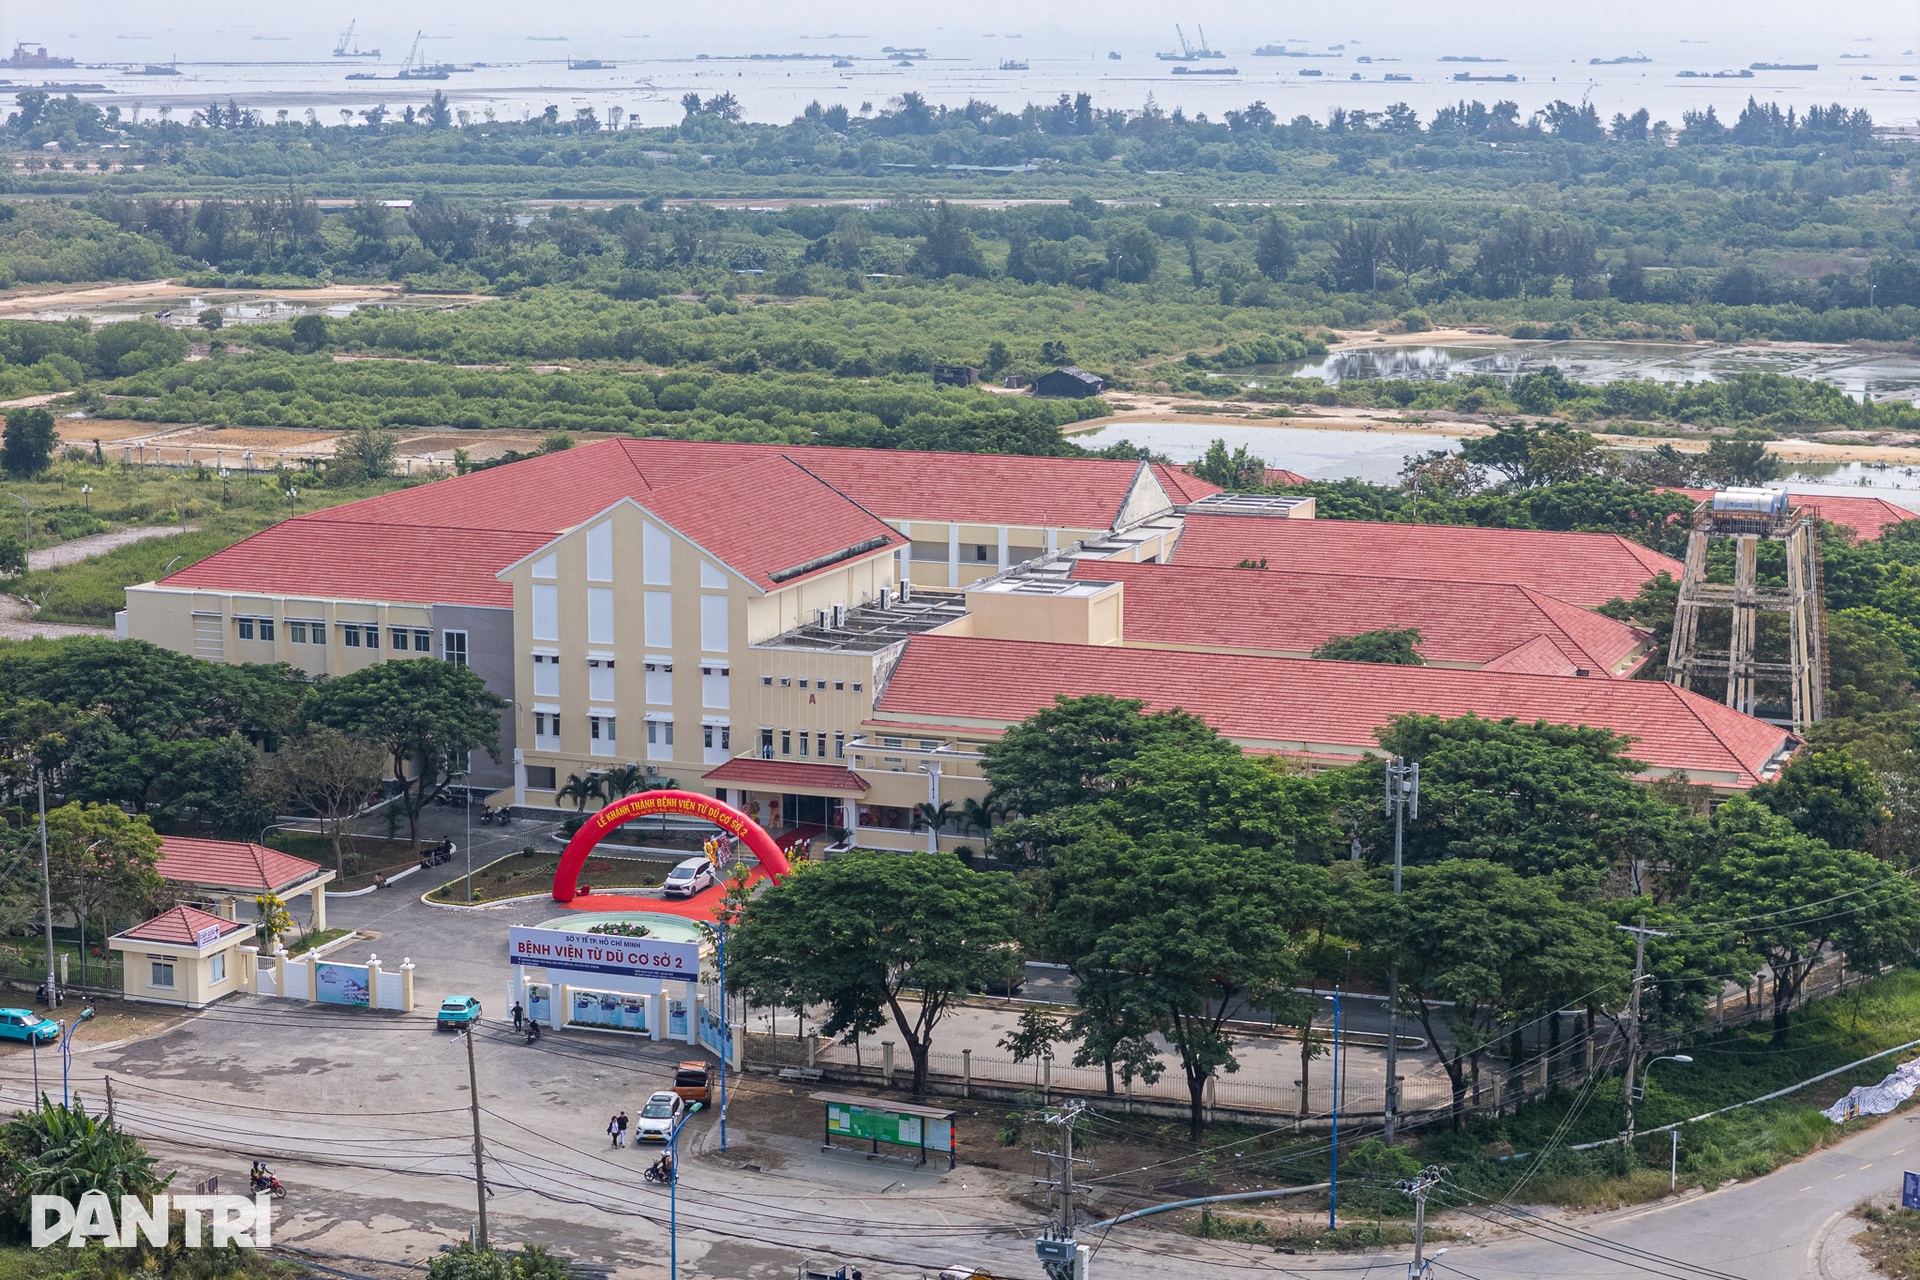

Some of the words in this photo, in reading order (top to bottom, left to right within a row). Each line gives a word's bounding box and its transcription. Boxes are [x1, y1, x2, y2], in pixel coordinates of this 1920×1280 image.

[808, 693, 816, 704] A
[596, 814, 608, 828] LỄ
[605, 804, 631, 822] KHÁNH
[630, 798, 655, 812] THÀNH
[657, 796, 677, 808] BỆNH
[678, 797, 696, 811] VIỆN
[708, 807, 720, 819] DŨ
[719, 813, 733, 825] CƠ
[740, 828, 748, 837] 2
[565, 934, 575, 942] SỞ
[581, 935, 590, 944] TẾ
[599, 936, 610, 946] HỒ
[610, 939, 623, 947] CHÍ
[623, 941, 641, 949] MINH
[518, 940, 550, 957] BỆNH
[555, 944, 583, 961] VIỆN
[587, 946, 603, 961] TỪ
[606, 948, 624, 963] DŨ
[628, 952, 649, 965] CƠ
[653, 951, 671, 968] SỞ
[675, 957, 683, 969] 2
